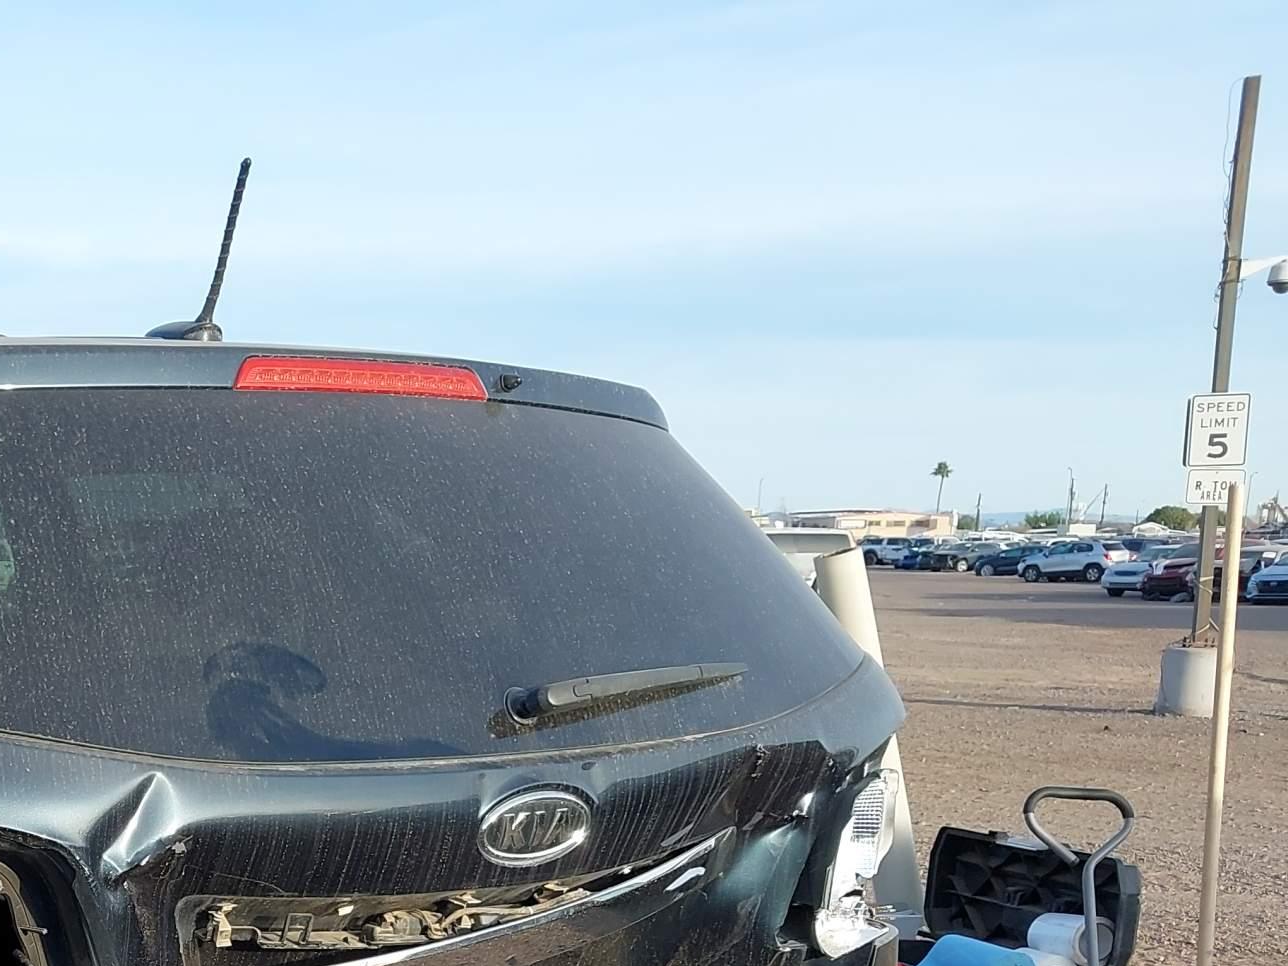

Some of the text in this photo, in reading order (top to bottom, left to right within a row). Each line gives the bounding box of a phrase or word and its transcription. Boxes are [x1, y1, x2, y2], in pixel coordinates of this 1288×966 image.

[1196, 401, 1246, 413] SPEED
[1200, 417, 1239, 428] LIMIT
[1206, 433, 1229, 459] 5
[1200, 490, 1223, 501] AREA
[496, 807, 573, 851] KIA
